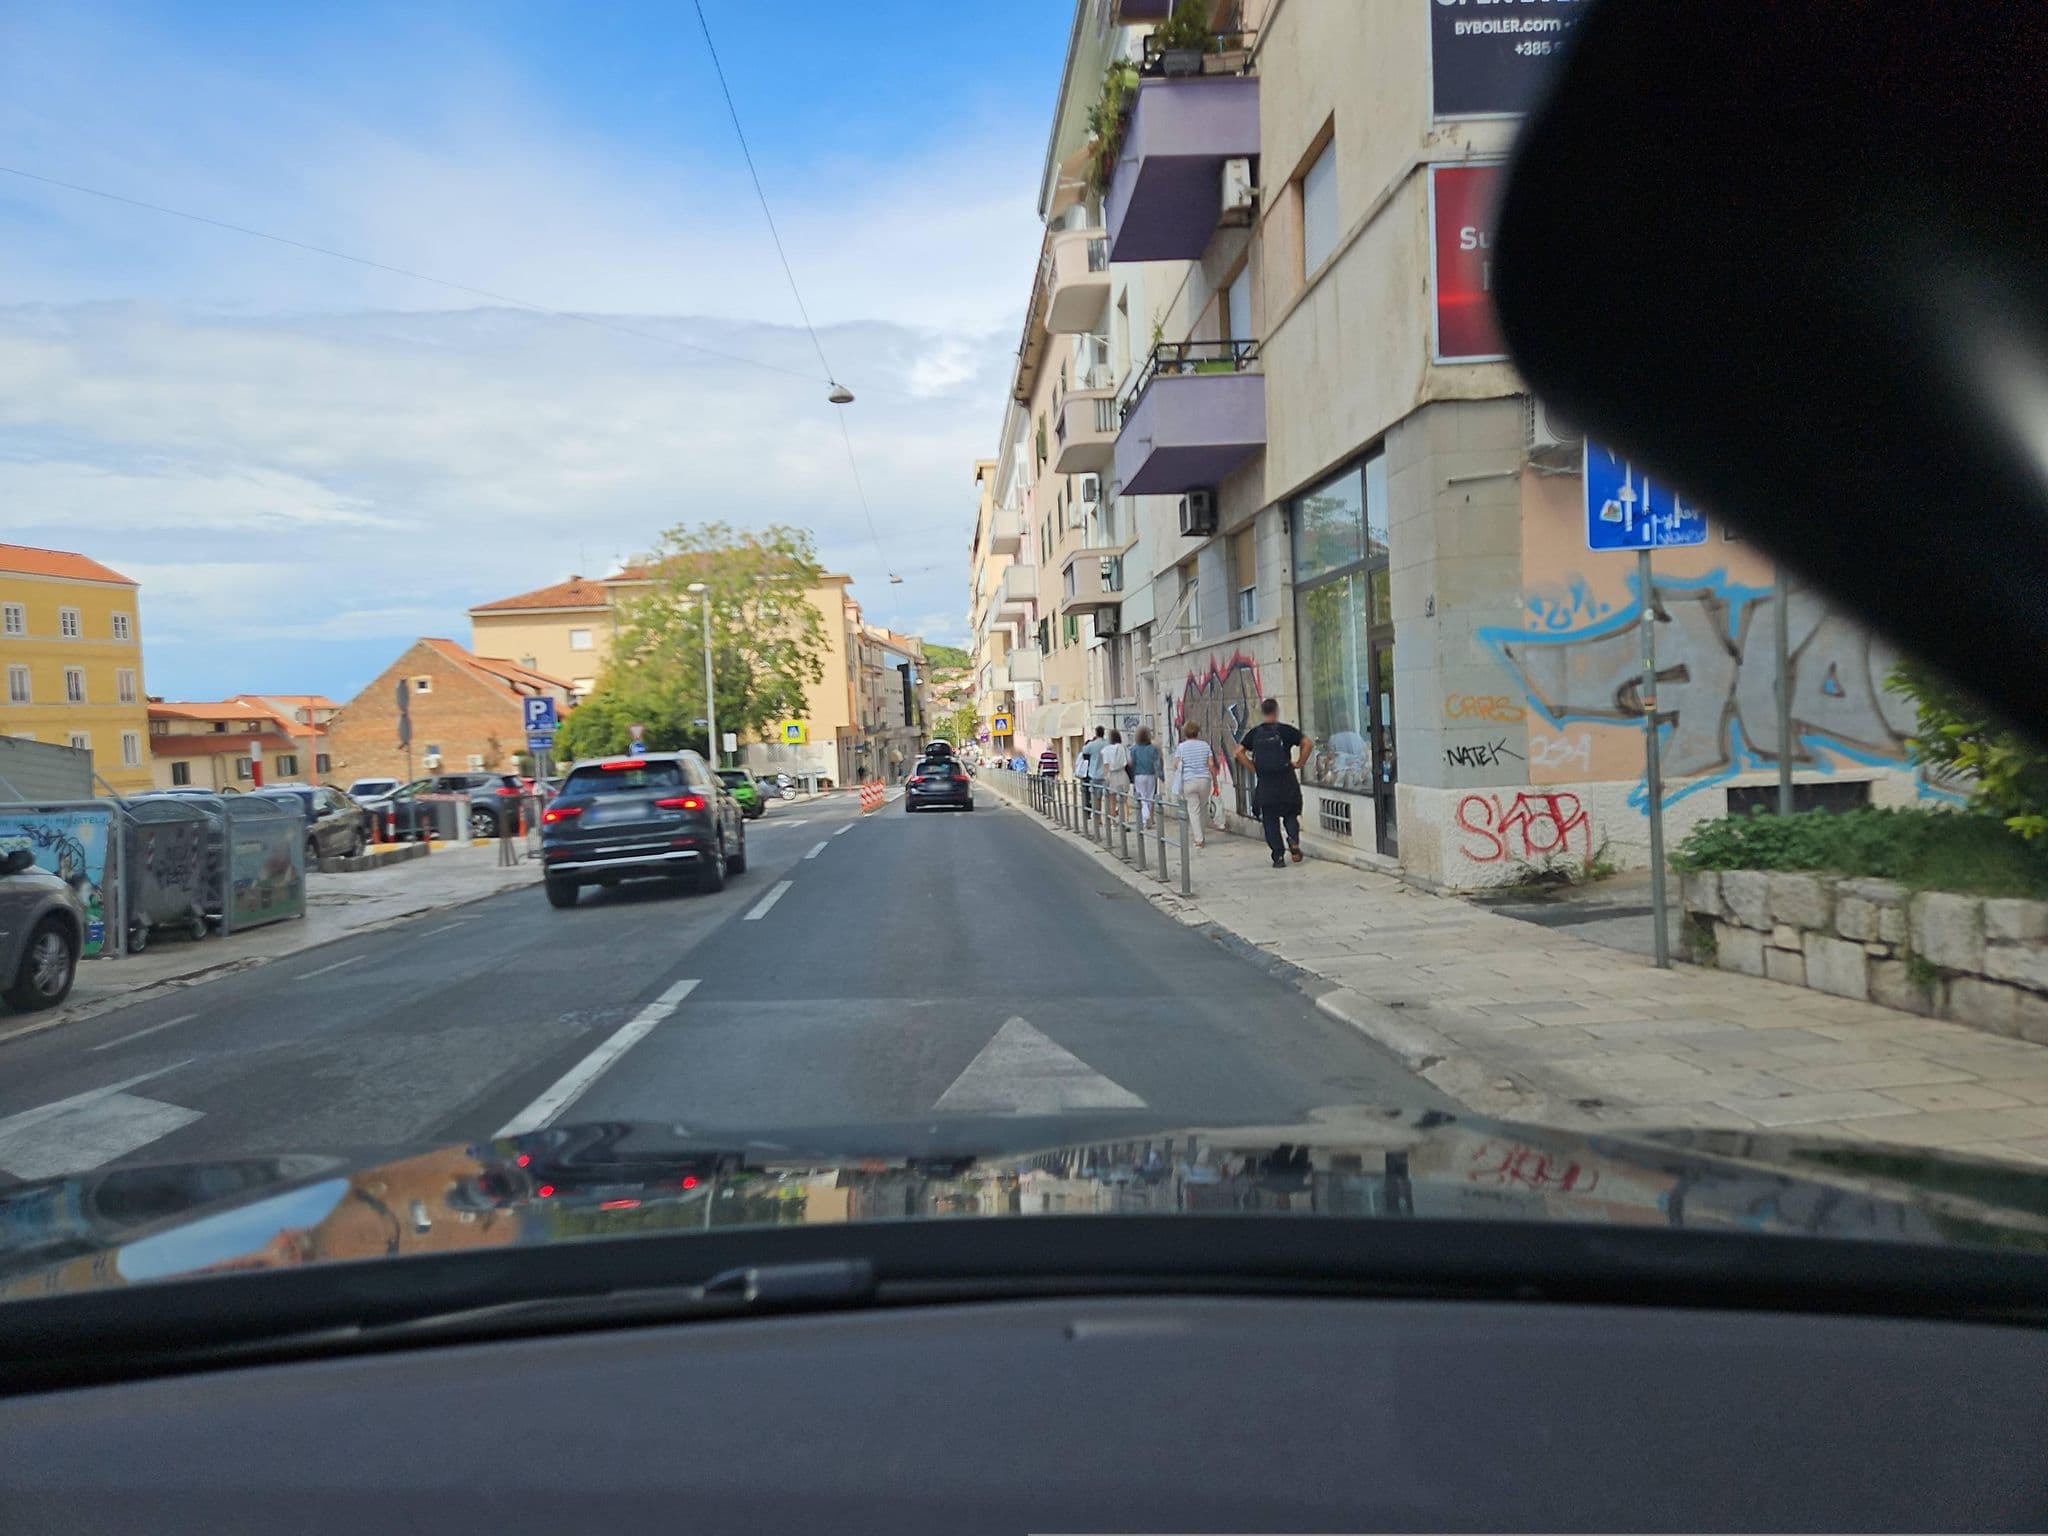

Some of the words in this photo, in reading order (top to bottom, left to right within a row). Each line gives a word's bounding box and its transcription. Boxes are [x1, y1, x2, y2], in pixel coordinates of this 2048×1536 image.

[1455, 19, 1561, 35] BYBOILER.com
[1514, 40, 1551, 56] +385
[529, 700, 547, 721] P
